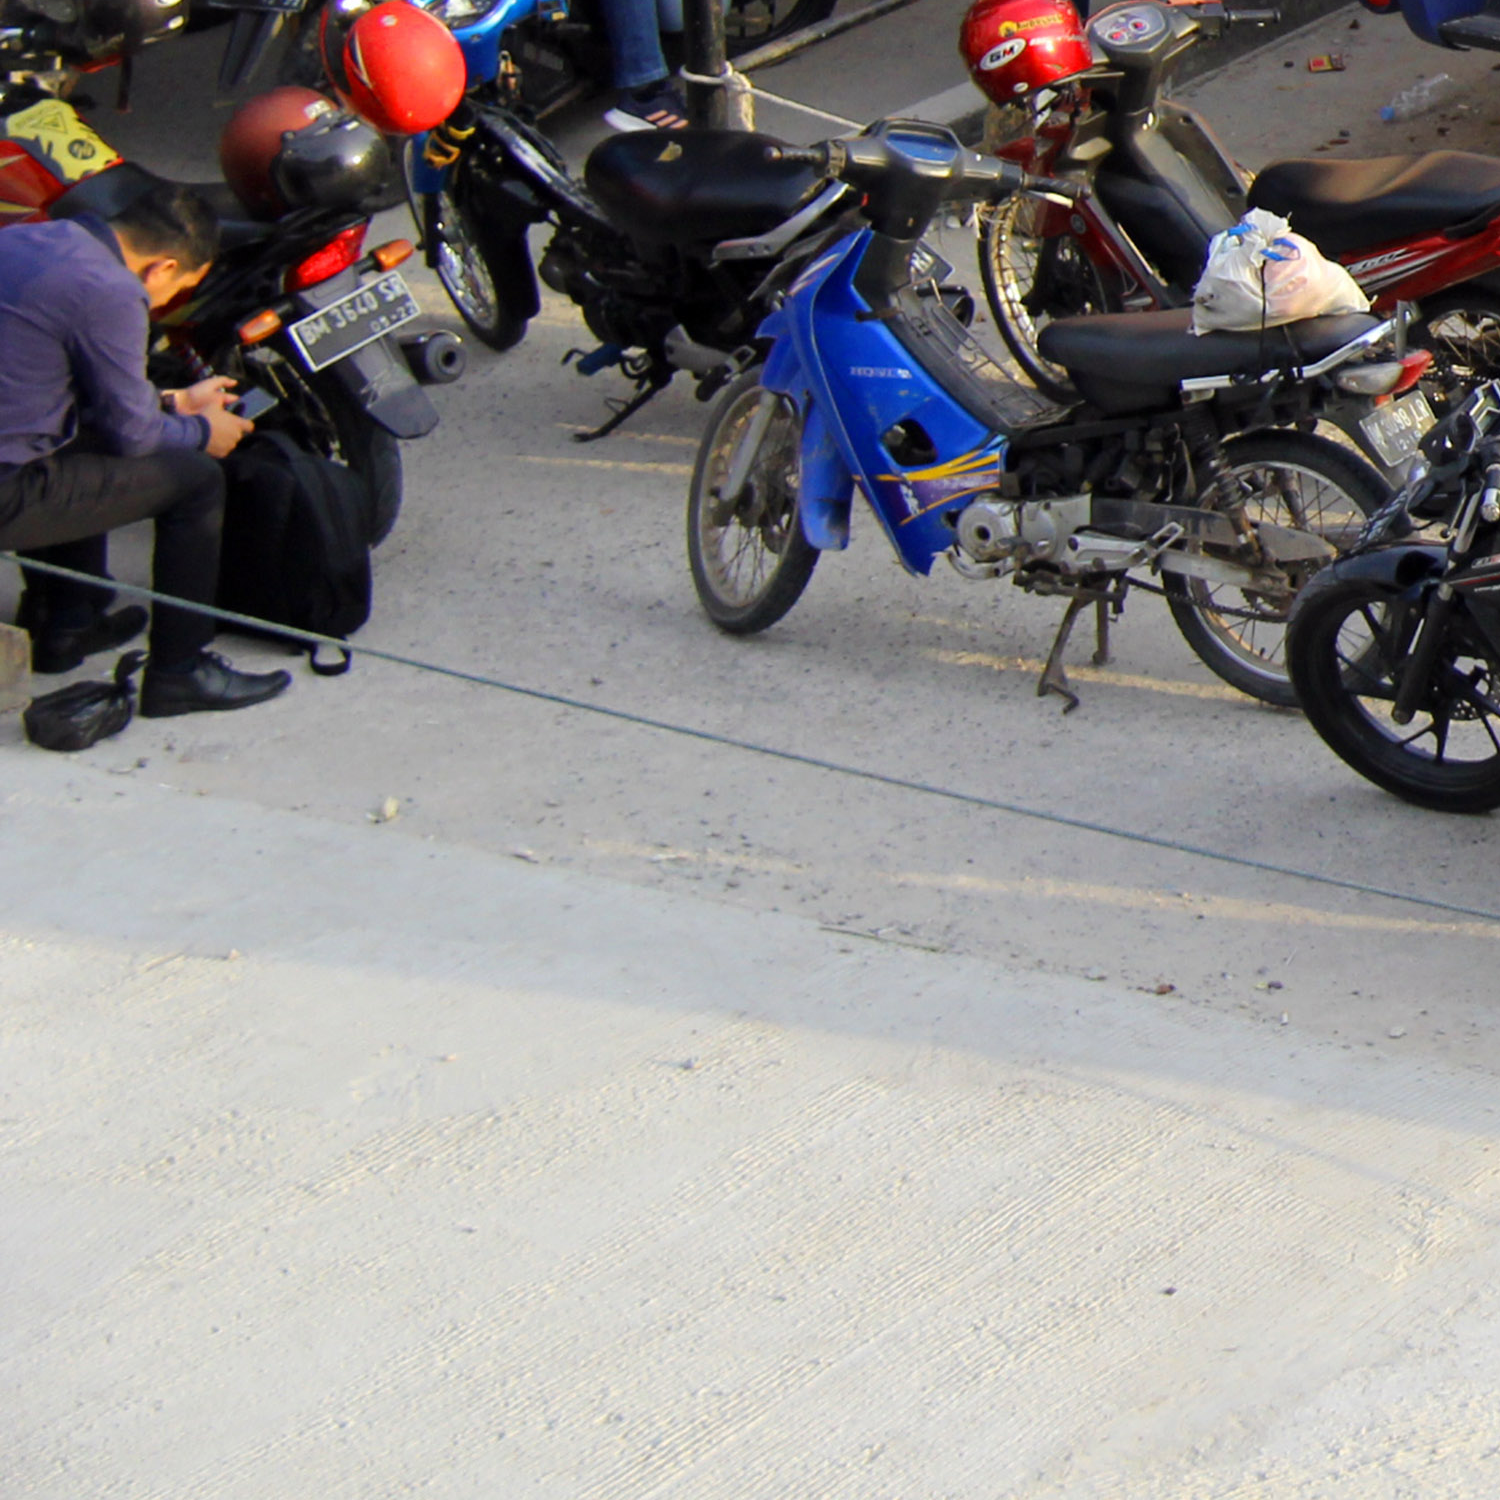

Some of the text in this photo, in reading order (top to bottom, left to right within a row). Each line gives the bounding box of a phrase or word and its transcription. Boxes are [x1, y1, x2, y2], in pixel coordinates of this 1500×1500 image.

[989, 45, 1016, 63] GM
[299, 318, 332, 347] BM
[333, 297, 380, 330] 3640
